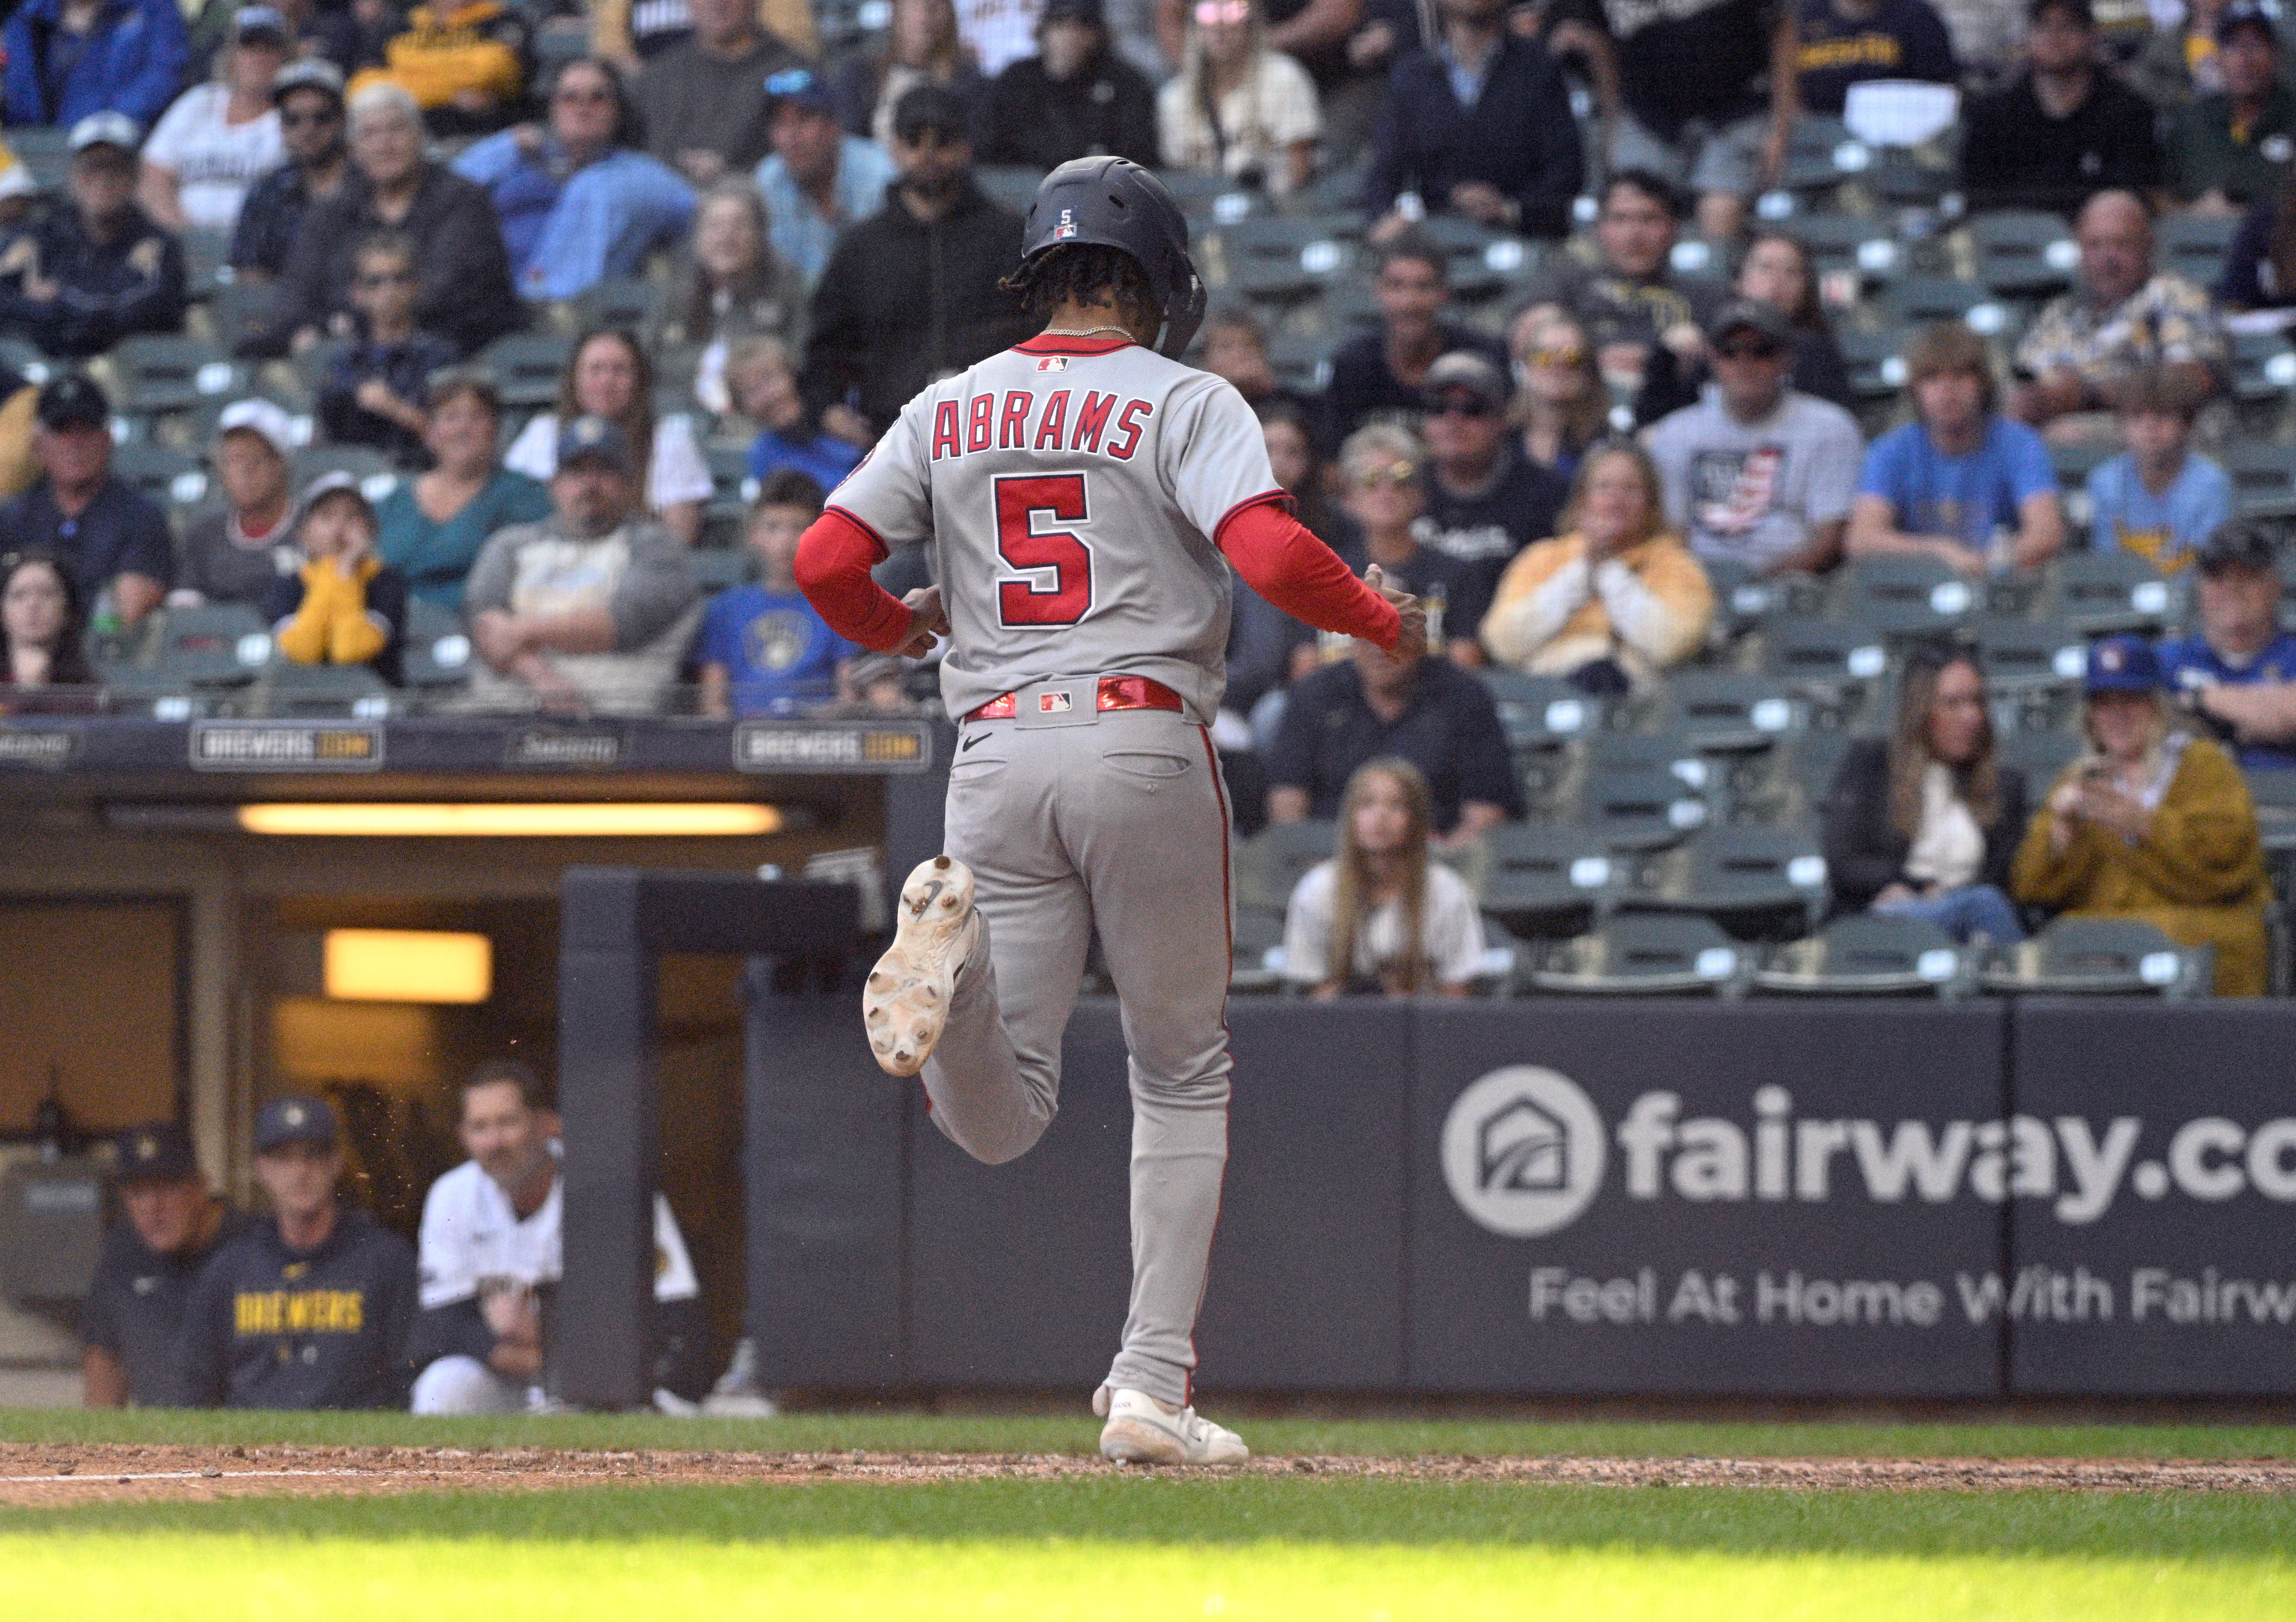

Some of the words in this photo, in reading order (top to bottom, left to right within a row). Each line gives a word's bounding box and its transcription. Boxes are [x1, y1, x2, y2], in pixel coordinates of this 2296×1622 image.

[1061, 209, 1071, 224] 5
[931, 388, 1154, 463] ABRAMS
[991, 470, 1095, 630] 5
[234, 1289, 364, 1334] BREWERS
[1528, 1267, 1655, 1322] Feel
[1669, 1270, 1738, 1322] At
[1756, 1273, 1942, 1324] Home
[1956, 1266, 2113, 1322] With
[2131, 1268, 2296, 1322] Fairw
